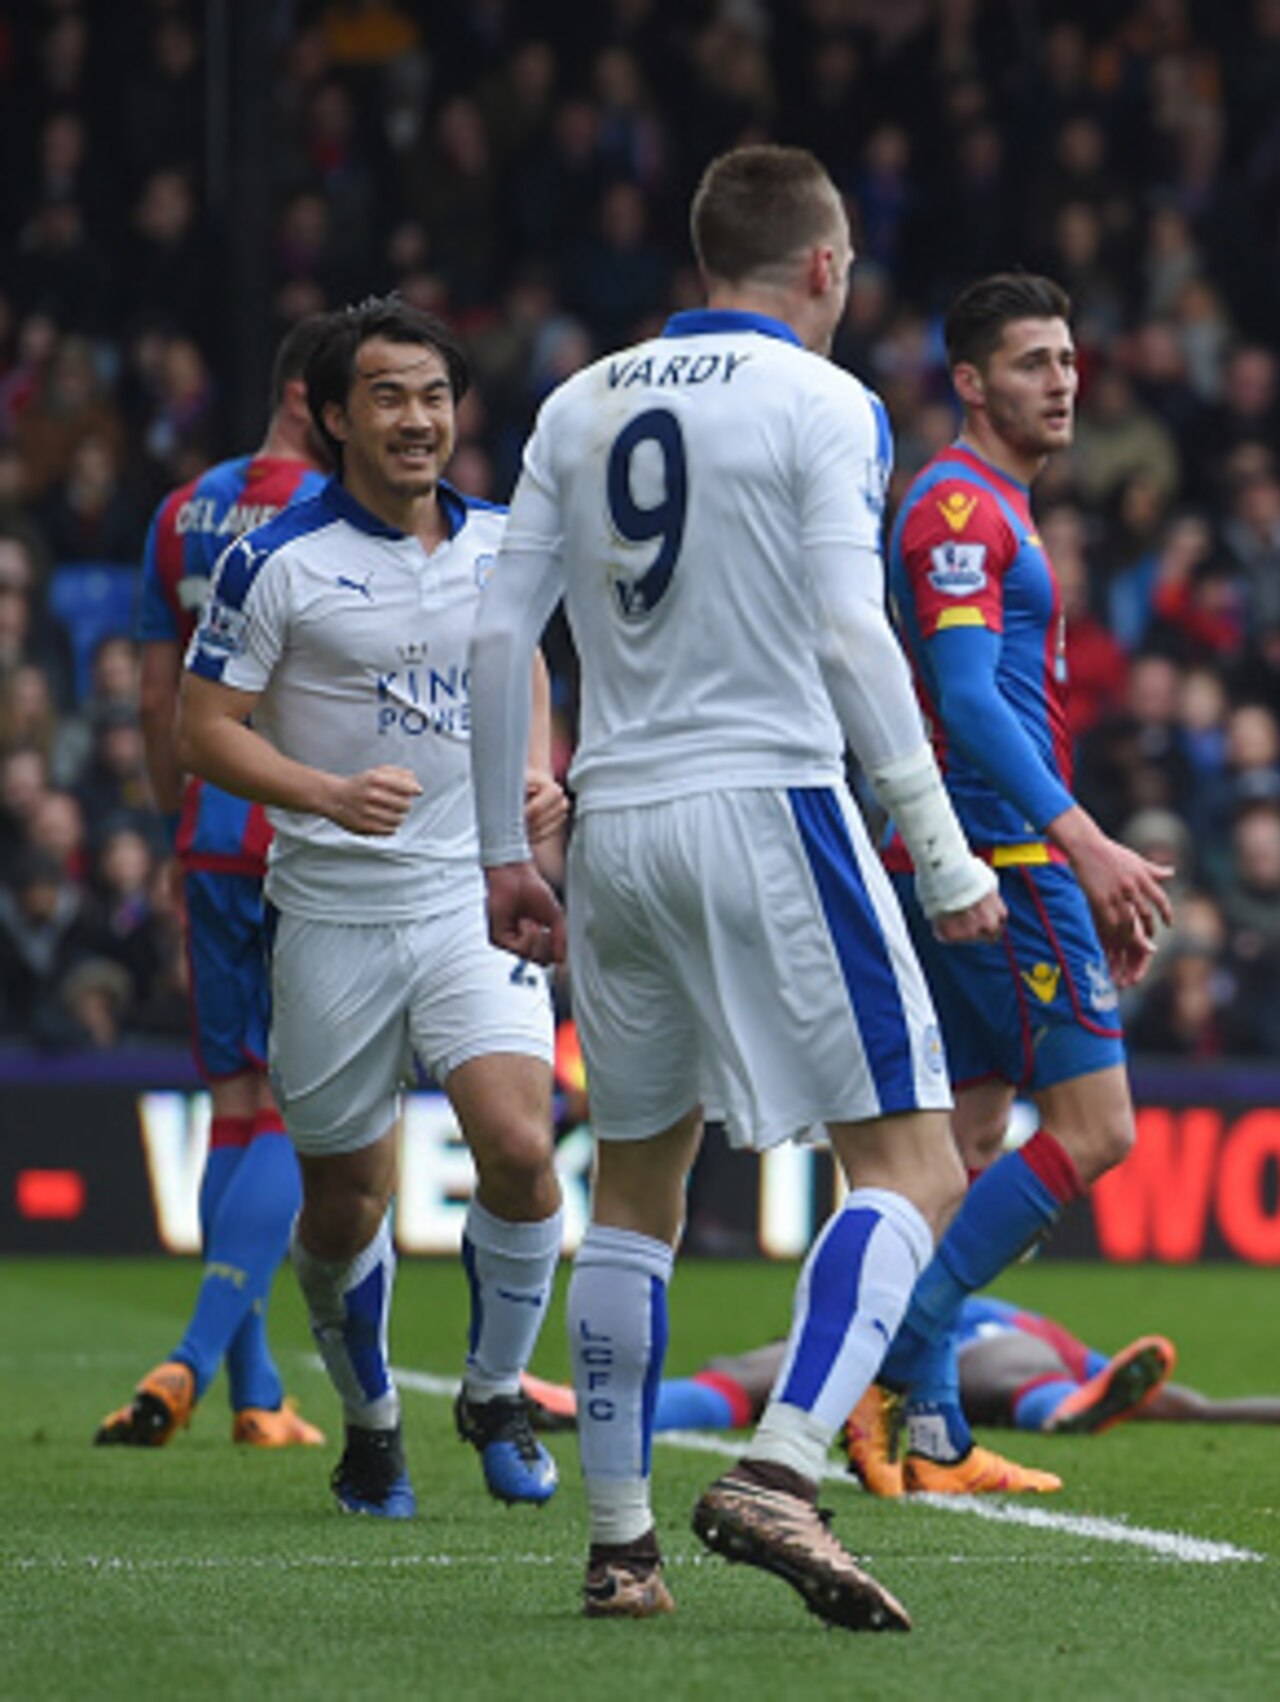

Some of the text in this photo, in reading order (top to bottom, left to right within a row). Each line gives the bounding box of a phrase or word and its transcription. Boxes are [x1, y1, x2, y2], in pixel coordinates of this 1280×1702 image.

[608, 351, 750, 389] VARDY
[175, 498, 281, 536] DELANE
[606, 408, 687, 624] 9
[377, 703, 472, 735] POWE
[580, 1318, 615, 1422] LCFC
